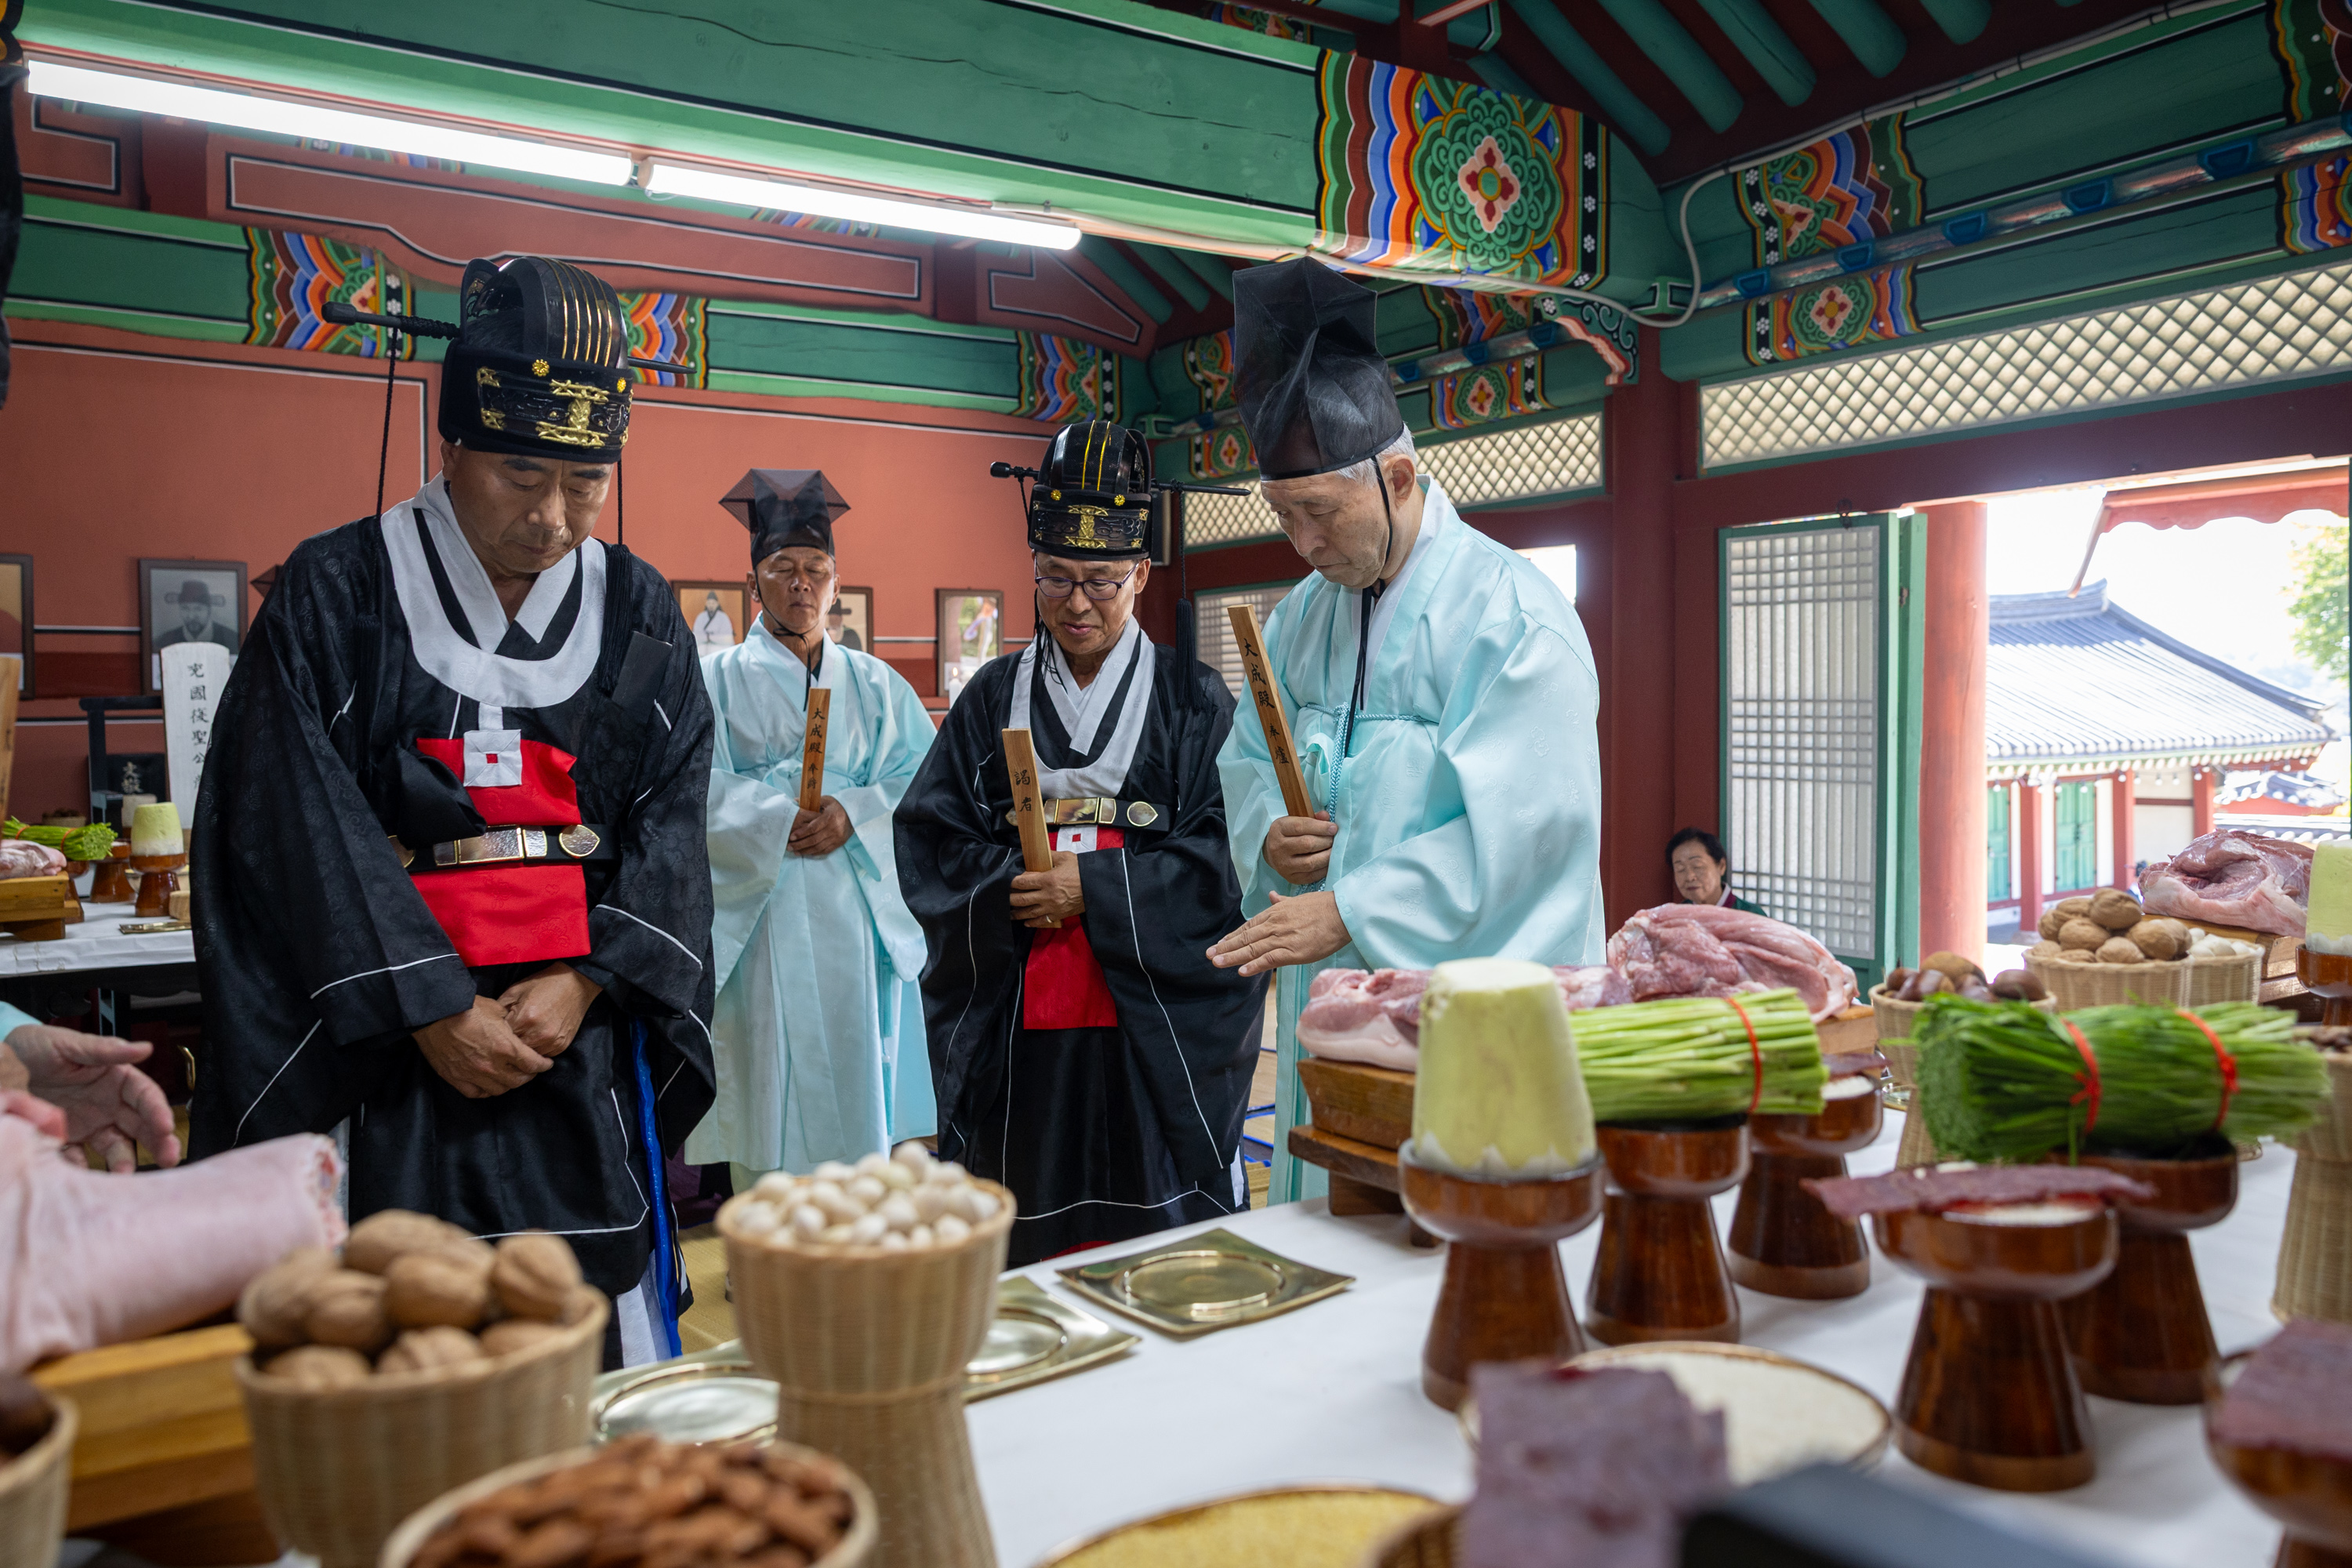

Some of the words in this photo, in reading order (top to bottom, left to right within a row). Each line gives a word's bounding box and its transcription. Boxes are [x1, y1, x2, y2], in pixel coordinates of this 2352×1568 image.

[1243, 637, 1276, 709] 大成殿
[808, 707, 826, 754] 大成殿
